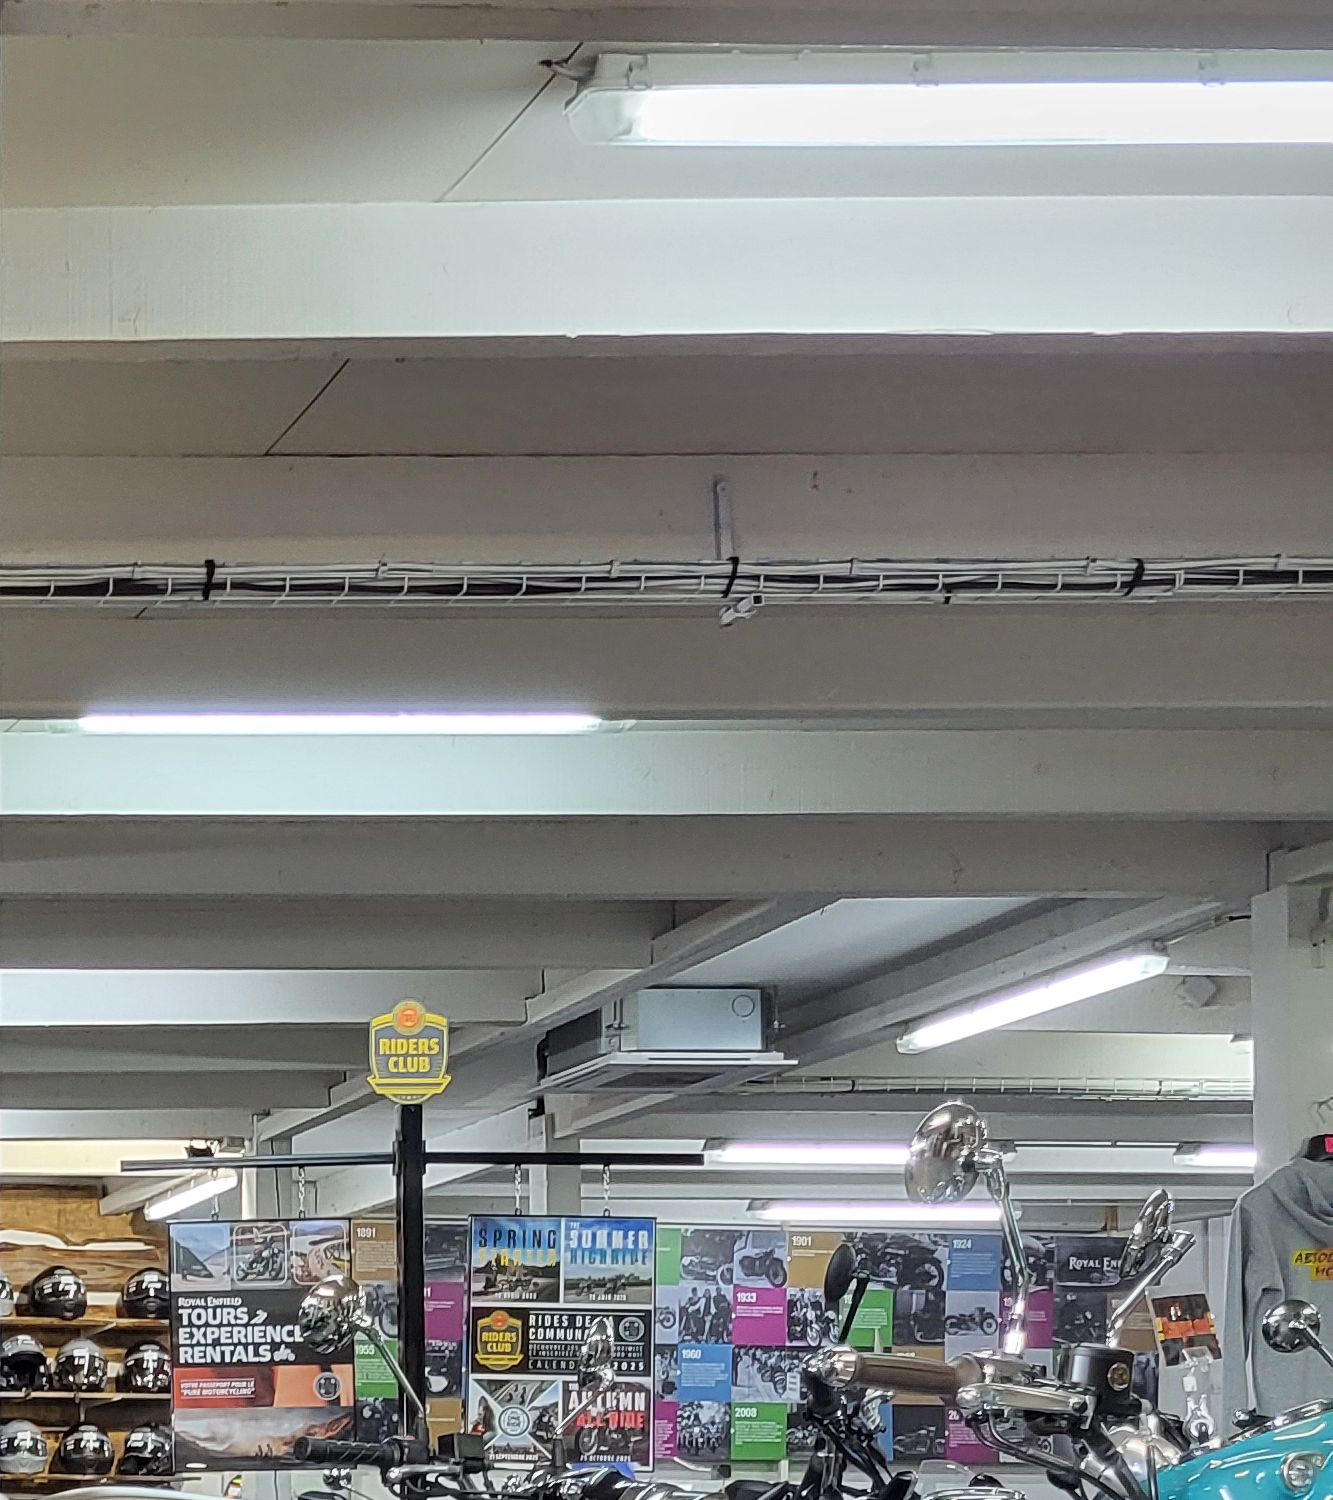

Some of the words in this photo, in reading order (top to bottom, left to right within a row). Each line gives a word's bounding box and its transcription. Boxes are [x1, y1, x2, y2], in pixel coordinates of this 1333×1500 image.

[379, 1038, 440, 1055] RIDERS
[388, 1056, 431, 1073] CLUB
[356, 1227, 376, 1238] 1891
[478, 1228, 557, 1249] SPRING
[569, 1230, 649, 1249] SUMMER
[791, 1236, 812, 1246] 1901
[952, 1239, 972, 1249] 1924
[1068, 1256, 1101, 1271] ROYAL
[178, 1307, 250, 1325] TOURS
[528, 1314, 569, 1328] RIDES
[575, 1315, 592, 1328] DE
[482, 1331, 518, 1342] RIDERS
[179, 1345, 272, 1364] RENTALS
[486, 1342, 512, 1353] CLUB
[681, 1349, 702, 1359] 1960
[528, 1360, 575, 1370] CALEND
[613, 1361, 645, 1371] 2025
